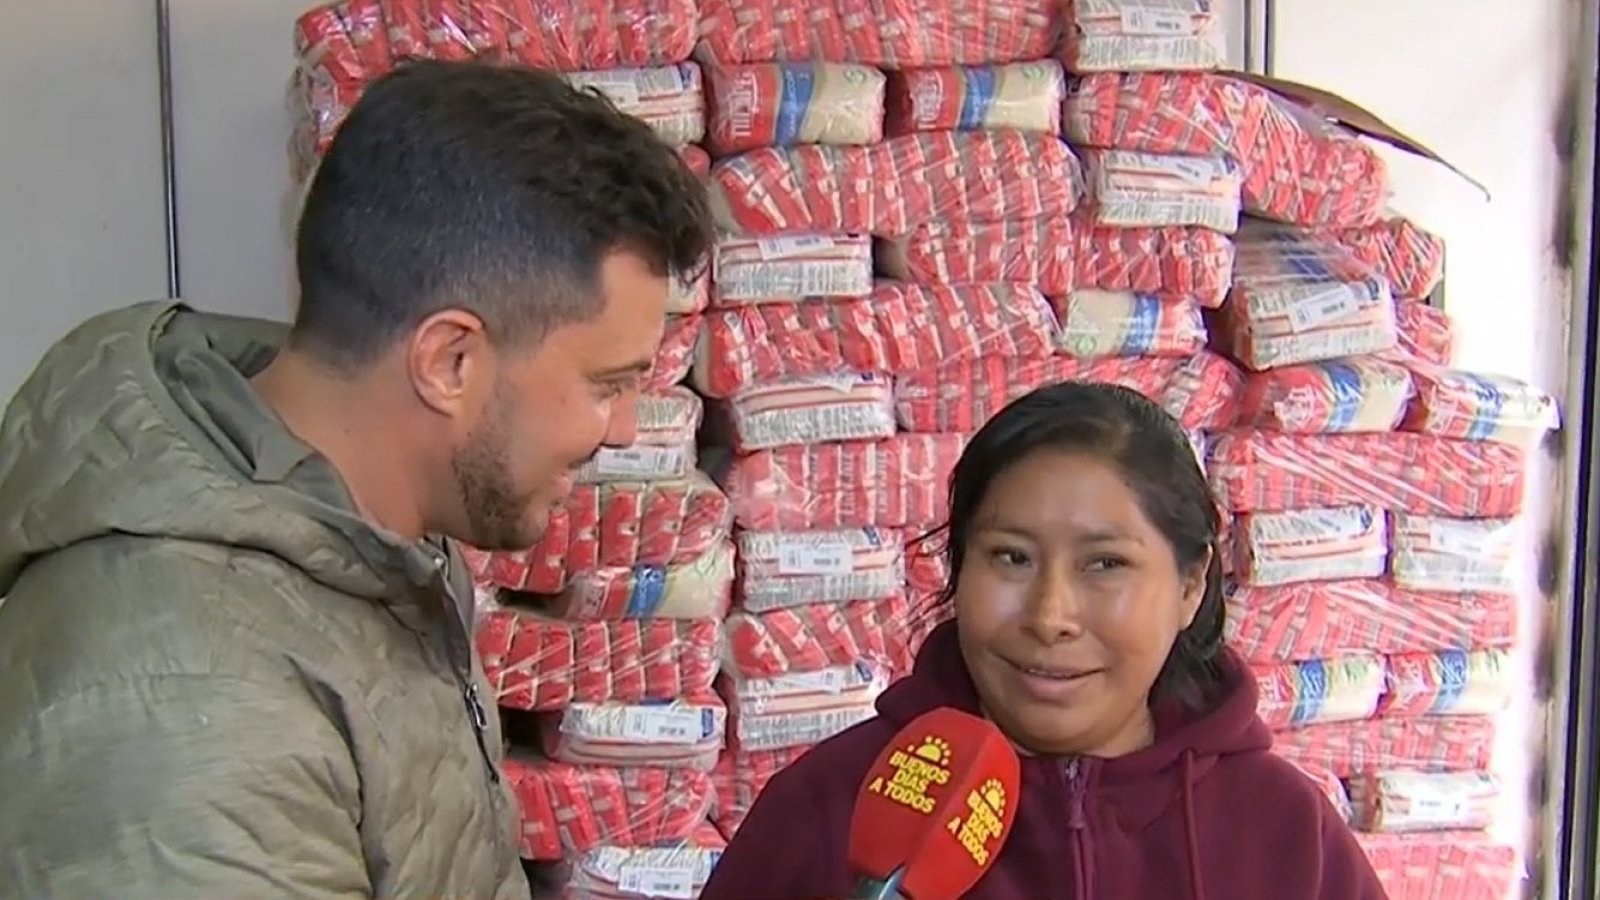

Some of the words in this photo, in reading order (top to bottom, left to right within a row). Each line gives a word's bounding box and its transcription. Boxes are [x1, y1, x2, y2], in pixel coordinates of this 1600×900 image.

[889, 751, 950, 785] BUENOS
[869, 778, 883, 793] A
[884, 780, 936, 813] TODOS
[967, 789, 1003, 838] BUENOS
[947, 816, 961, 835] A
[958, 823, 989, 866] TODOS
